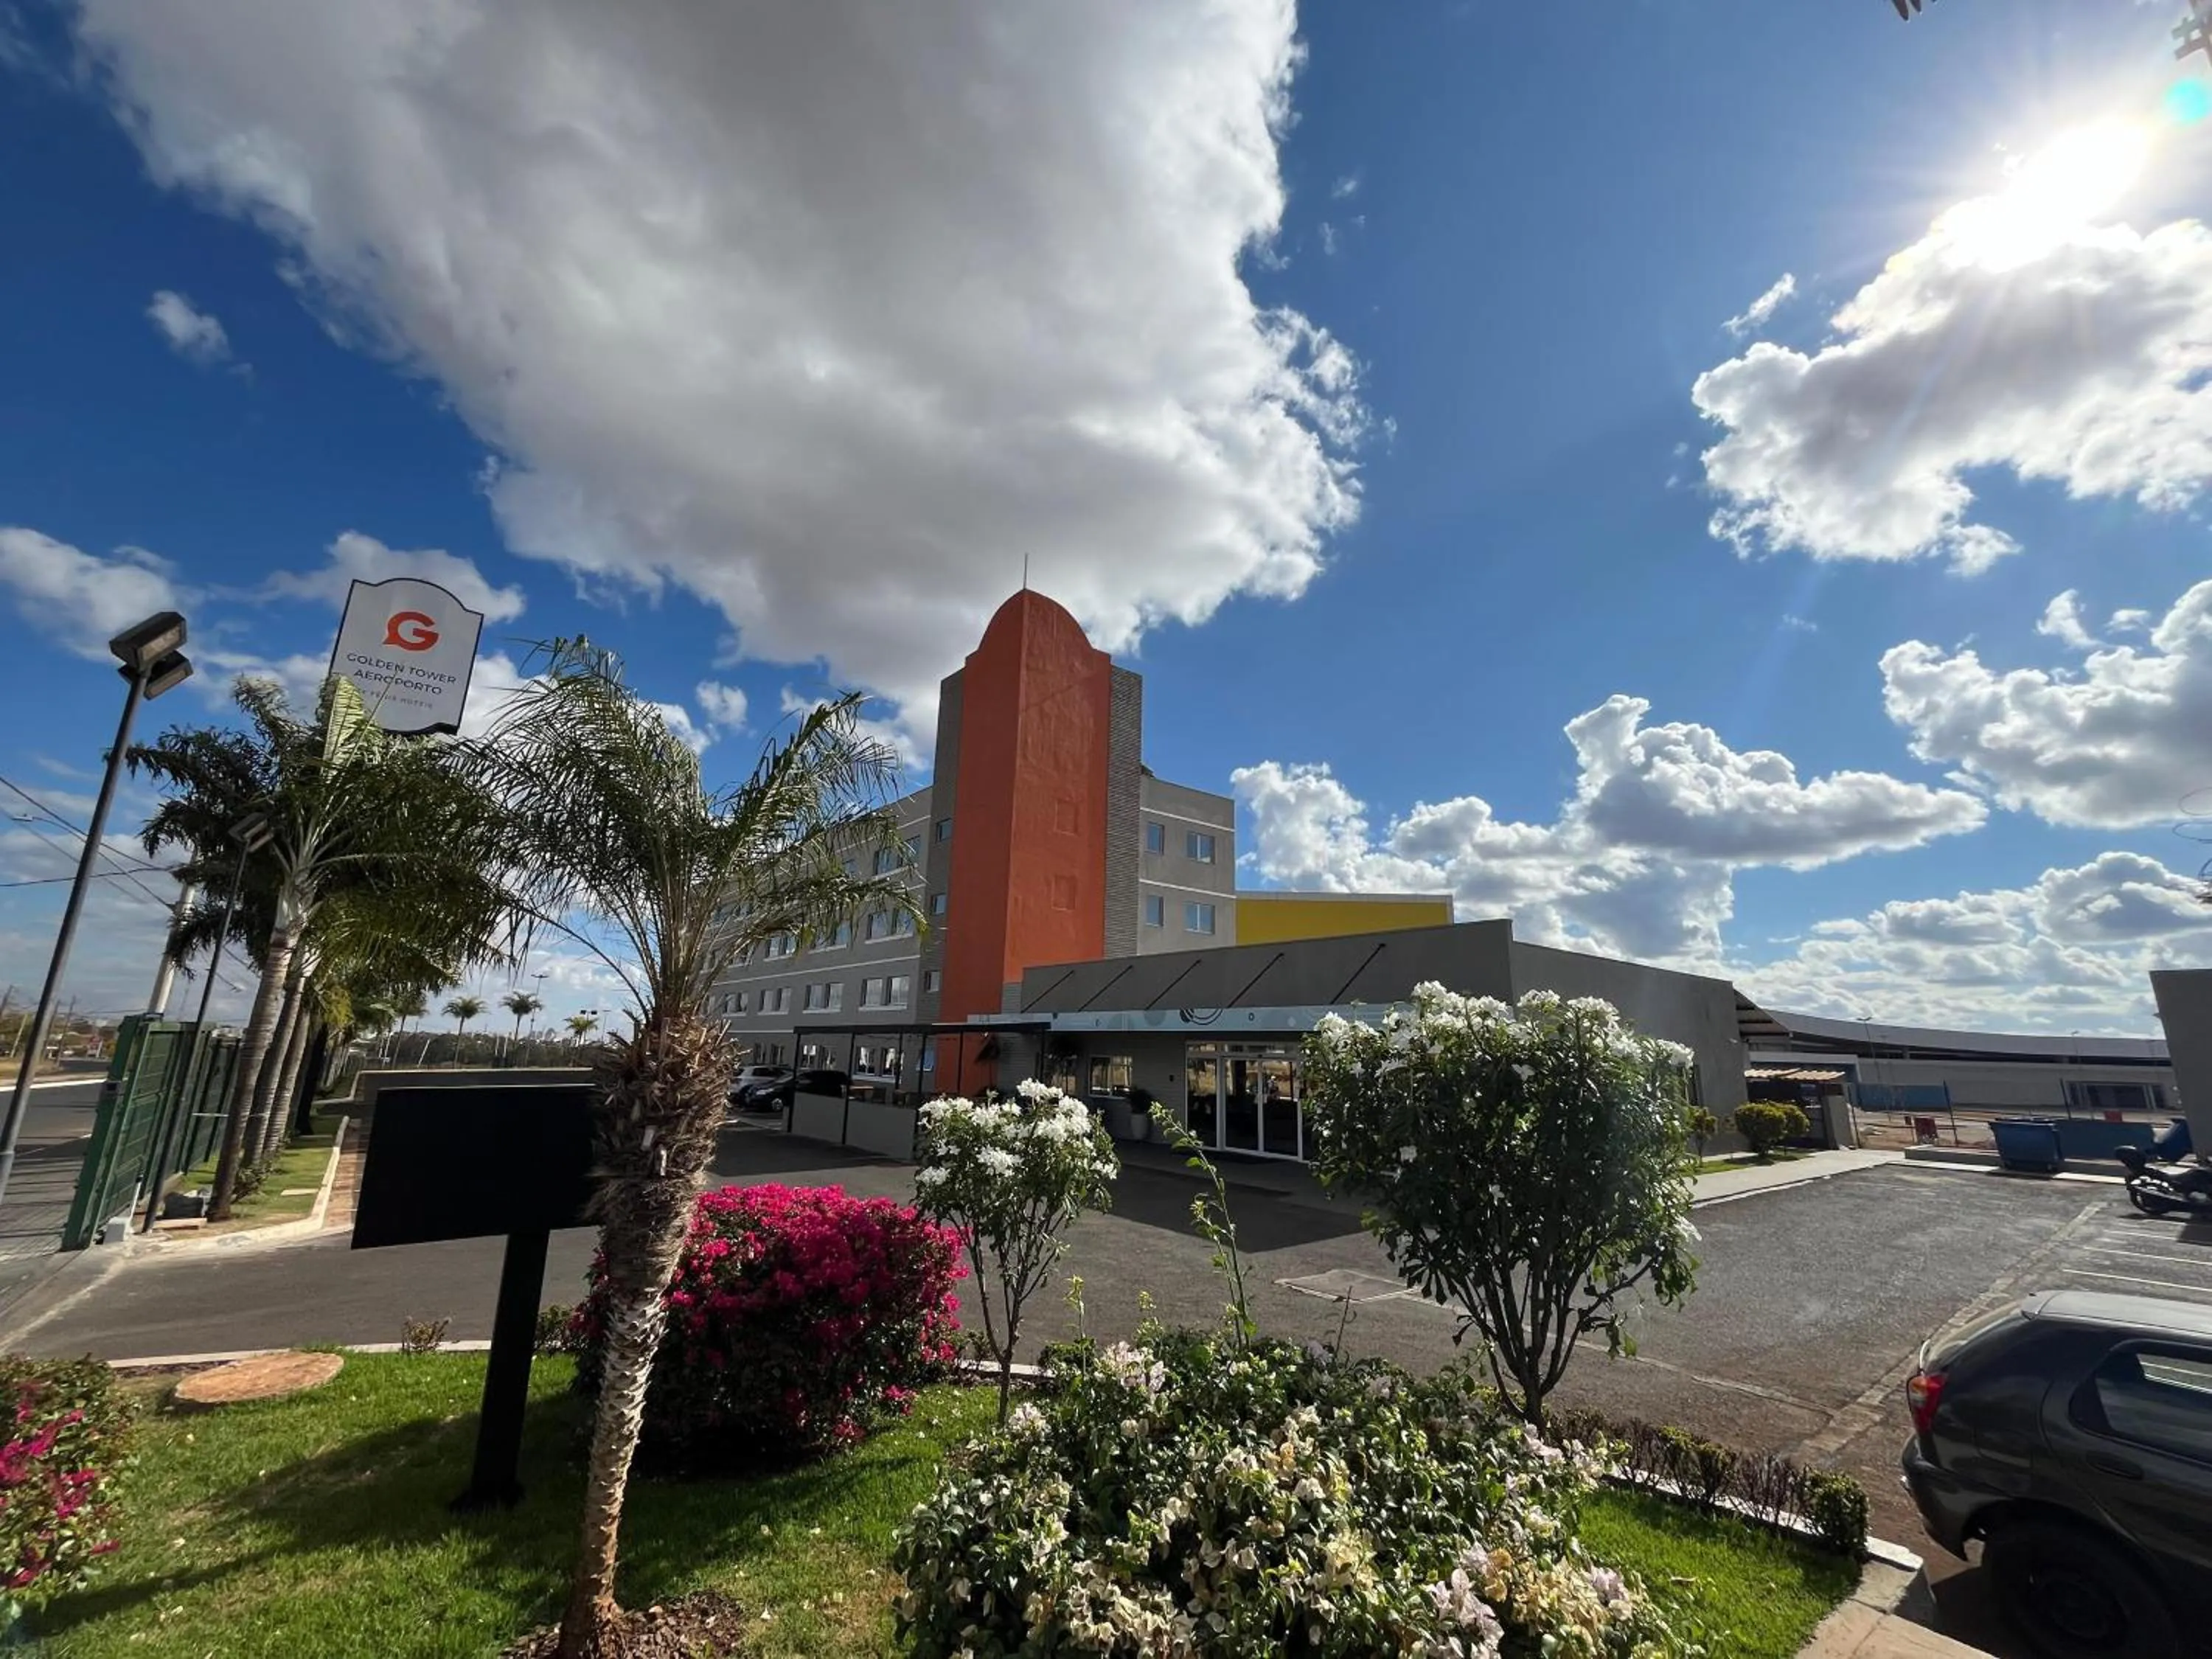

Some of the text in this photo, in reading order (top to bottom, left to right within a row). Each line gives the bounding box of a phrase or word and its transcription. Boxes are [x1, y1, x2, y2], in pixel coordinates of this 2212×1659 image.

[382, 611, 439, 651] G
[347, 653, 456, 684] GOLDEN TOWER
[353, 669, 442, 695] AEROPORTO
